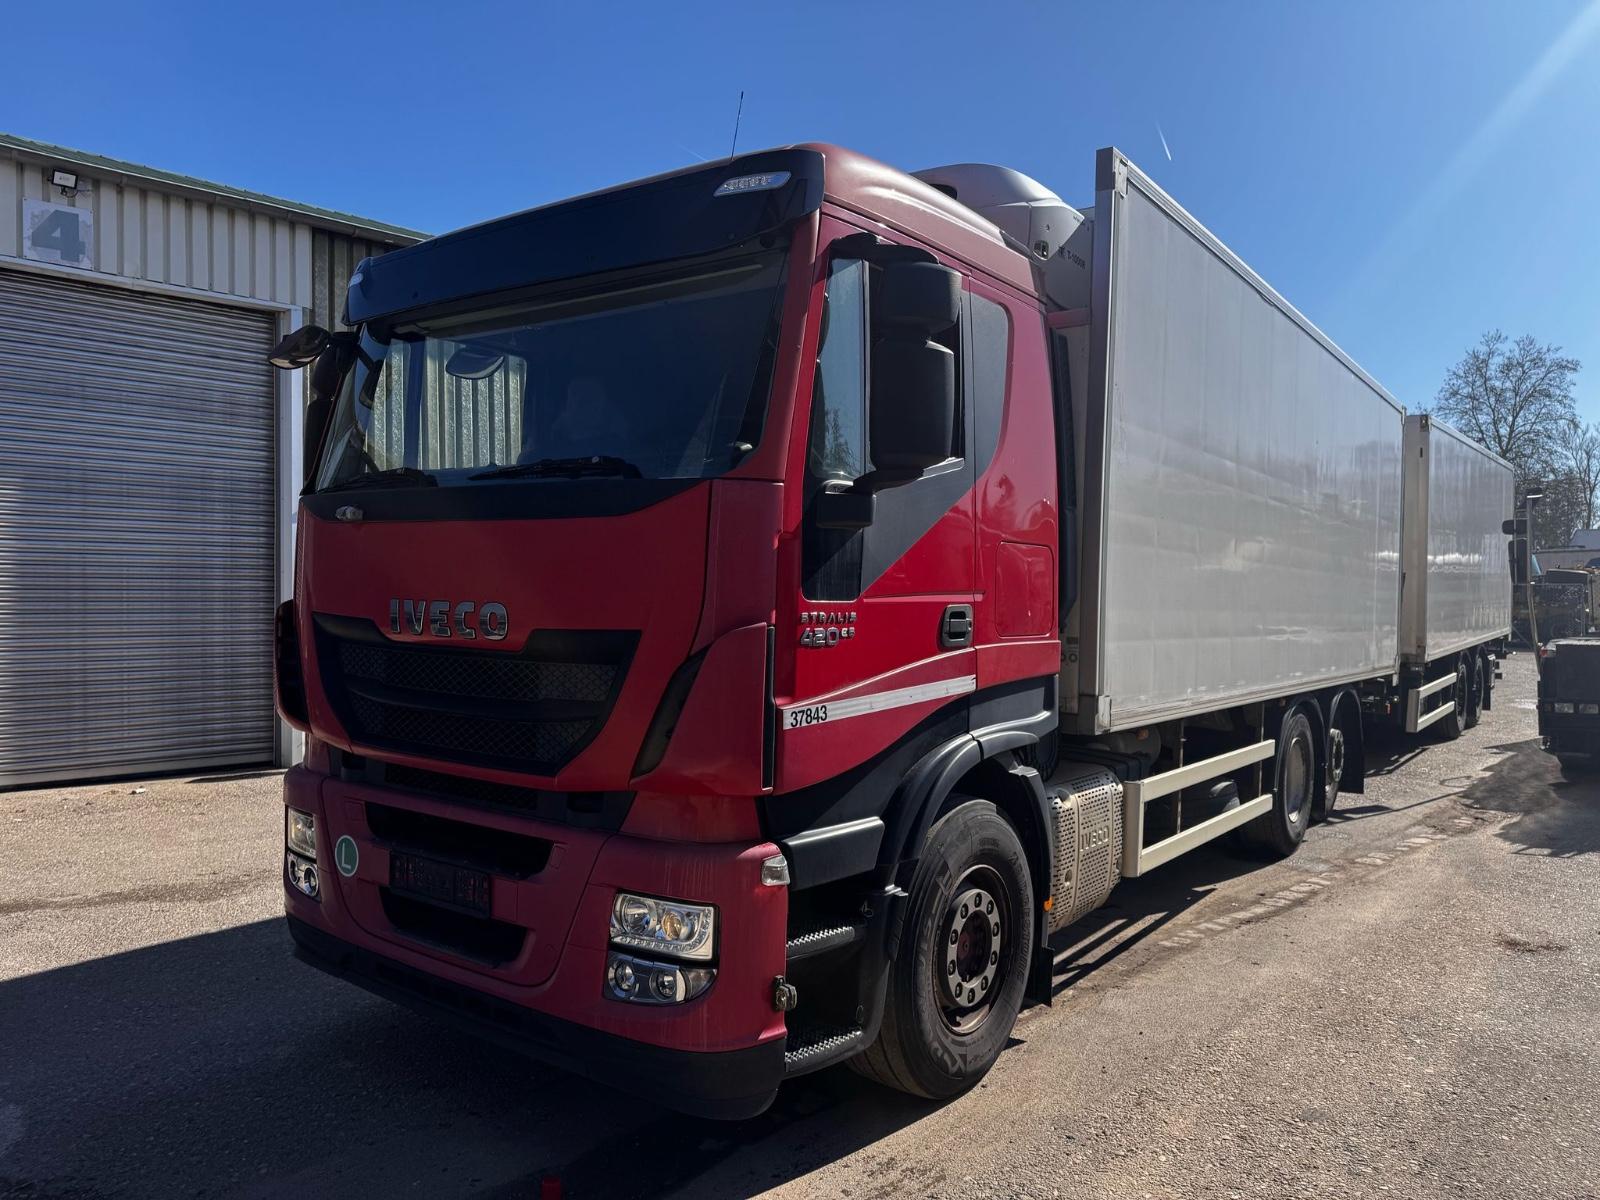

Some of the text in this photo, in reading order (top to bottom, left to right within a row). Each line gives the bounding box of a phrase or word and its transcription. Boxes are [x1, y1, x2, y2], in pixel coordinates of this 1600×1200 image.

[31, 209, 86, 263] 4
[389, 598, 508, 641] IVECO
[800, 611, 857, 624] STRALIS
[800, 627, 839, 647] 420
[790, 705, 828, 727] 37843
[1080, 825, 1110, 852] IVECO
[341, 841, 352, 870] L
